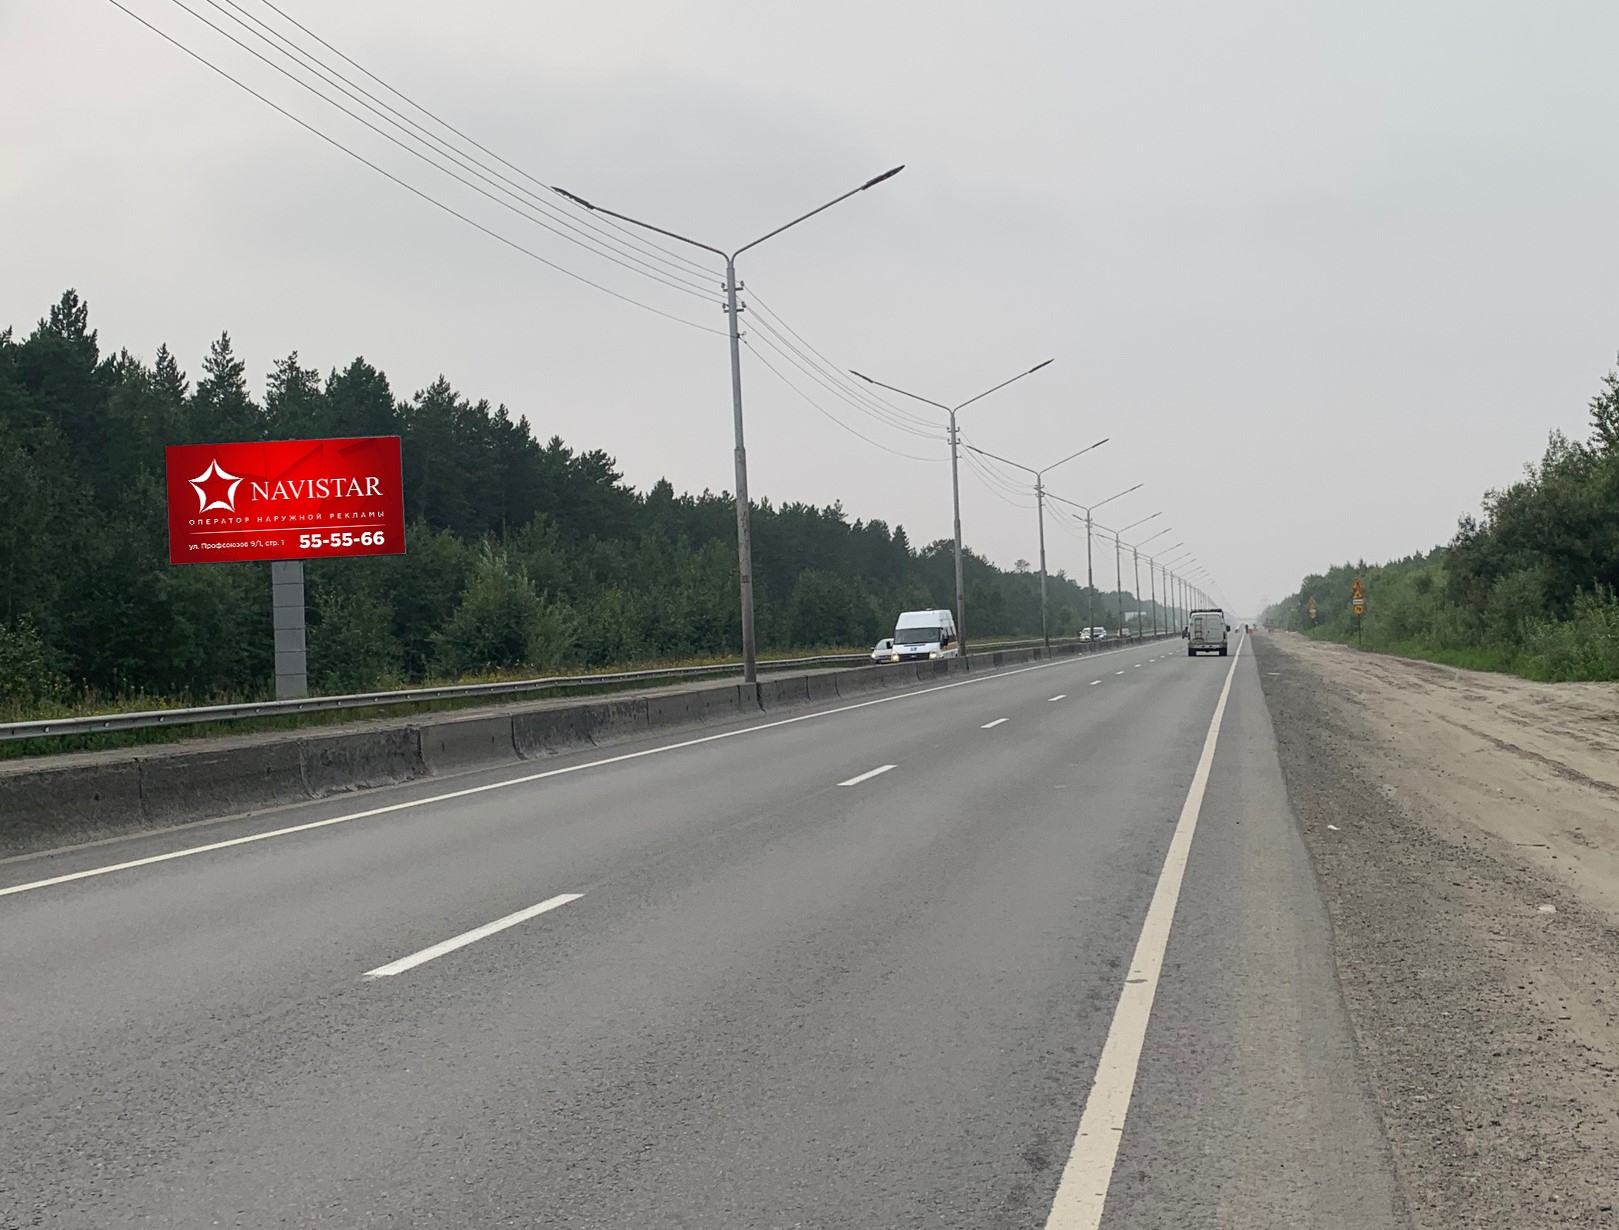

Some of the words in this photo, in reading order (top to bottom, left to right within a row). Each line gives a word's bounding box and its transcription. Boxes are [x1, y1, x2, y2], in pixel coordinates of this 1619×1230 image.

[250, 476, 384, 501] NAVISTAR
[188, 517, 251, 526] ОПЕРАТОР
[257, 512, 322, 523] НАРУЖНОЙ
[329, 511, 385, 519] РЕКЛАМЫ
[201, 541, 249, 550] Профсоюзов
[299, 531, 385, 549] 55-55-66
